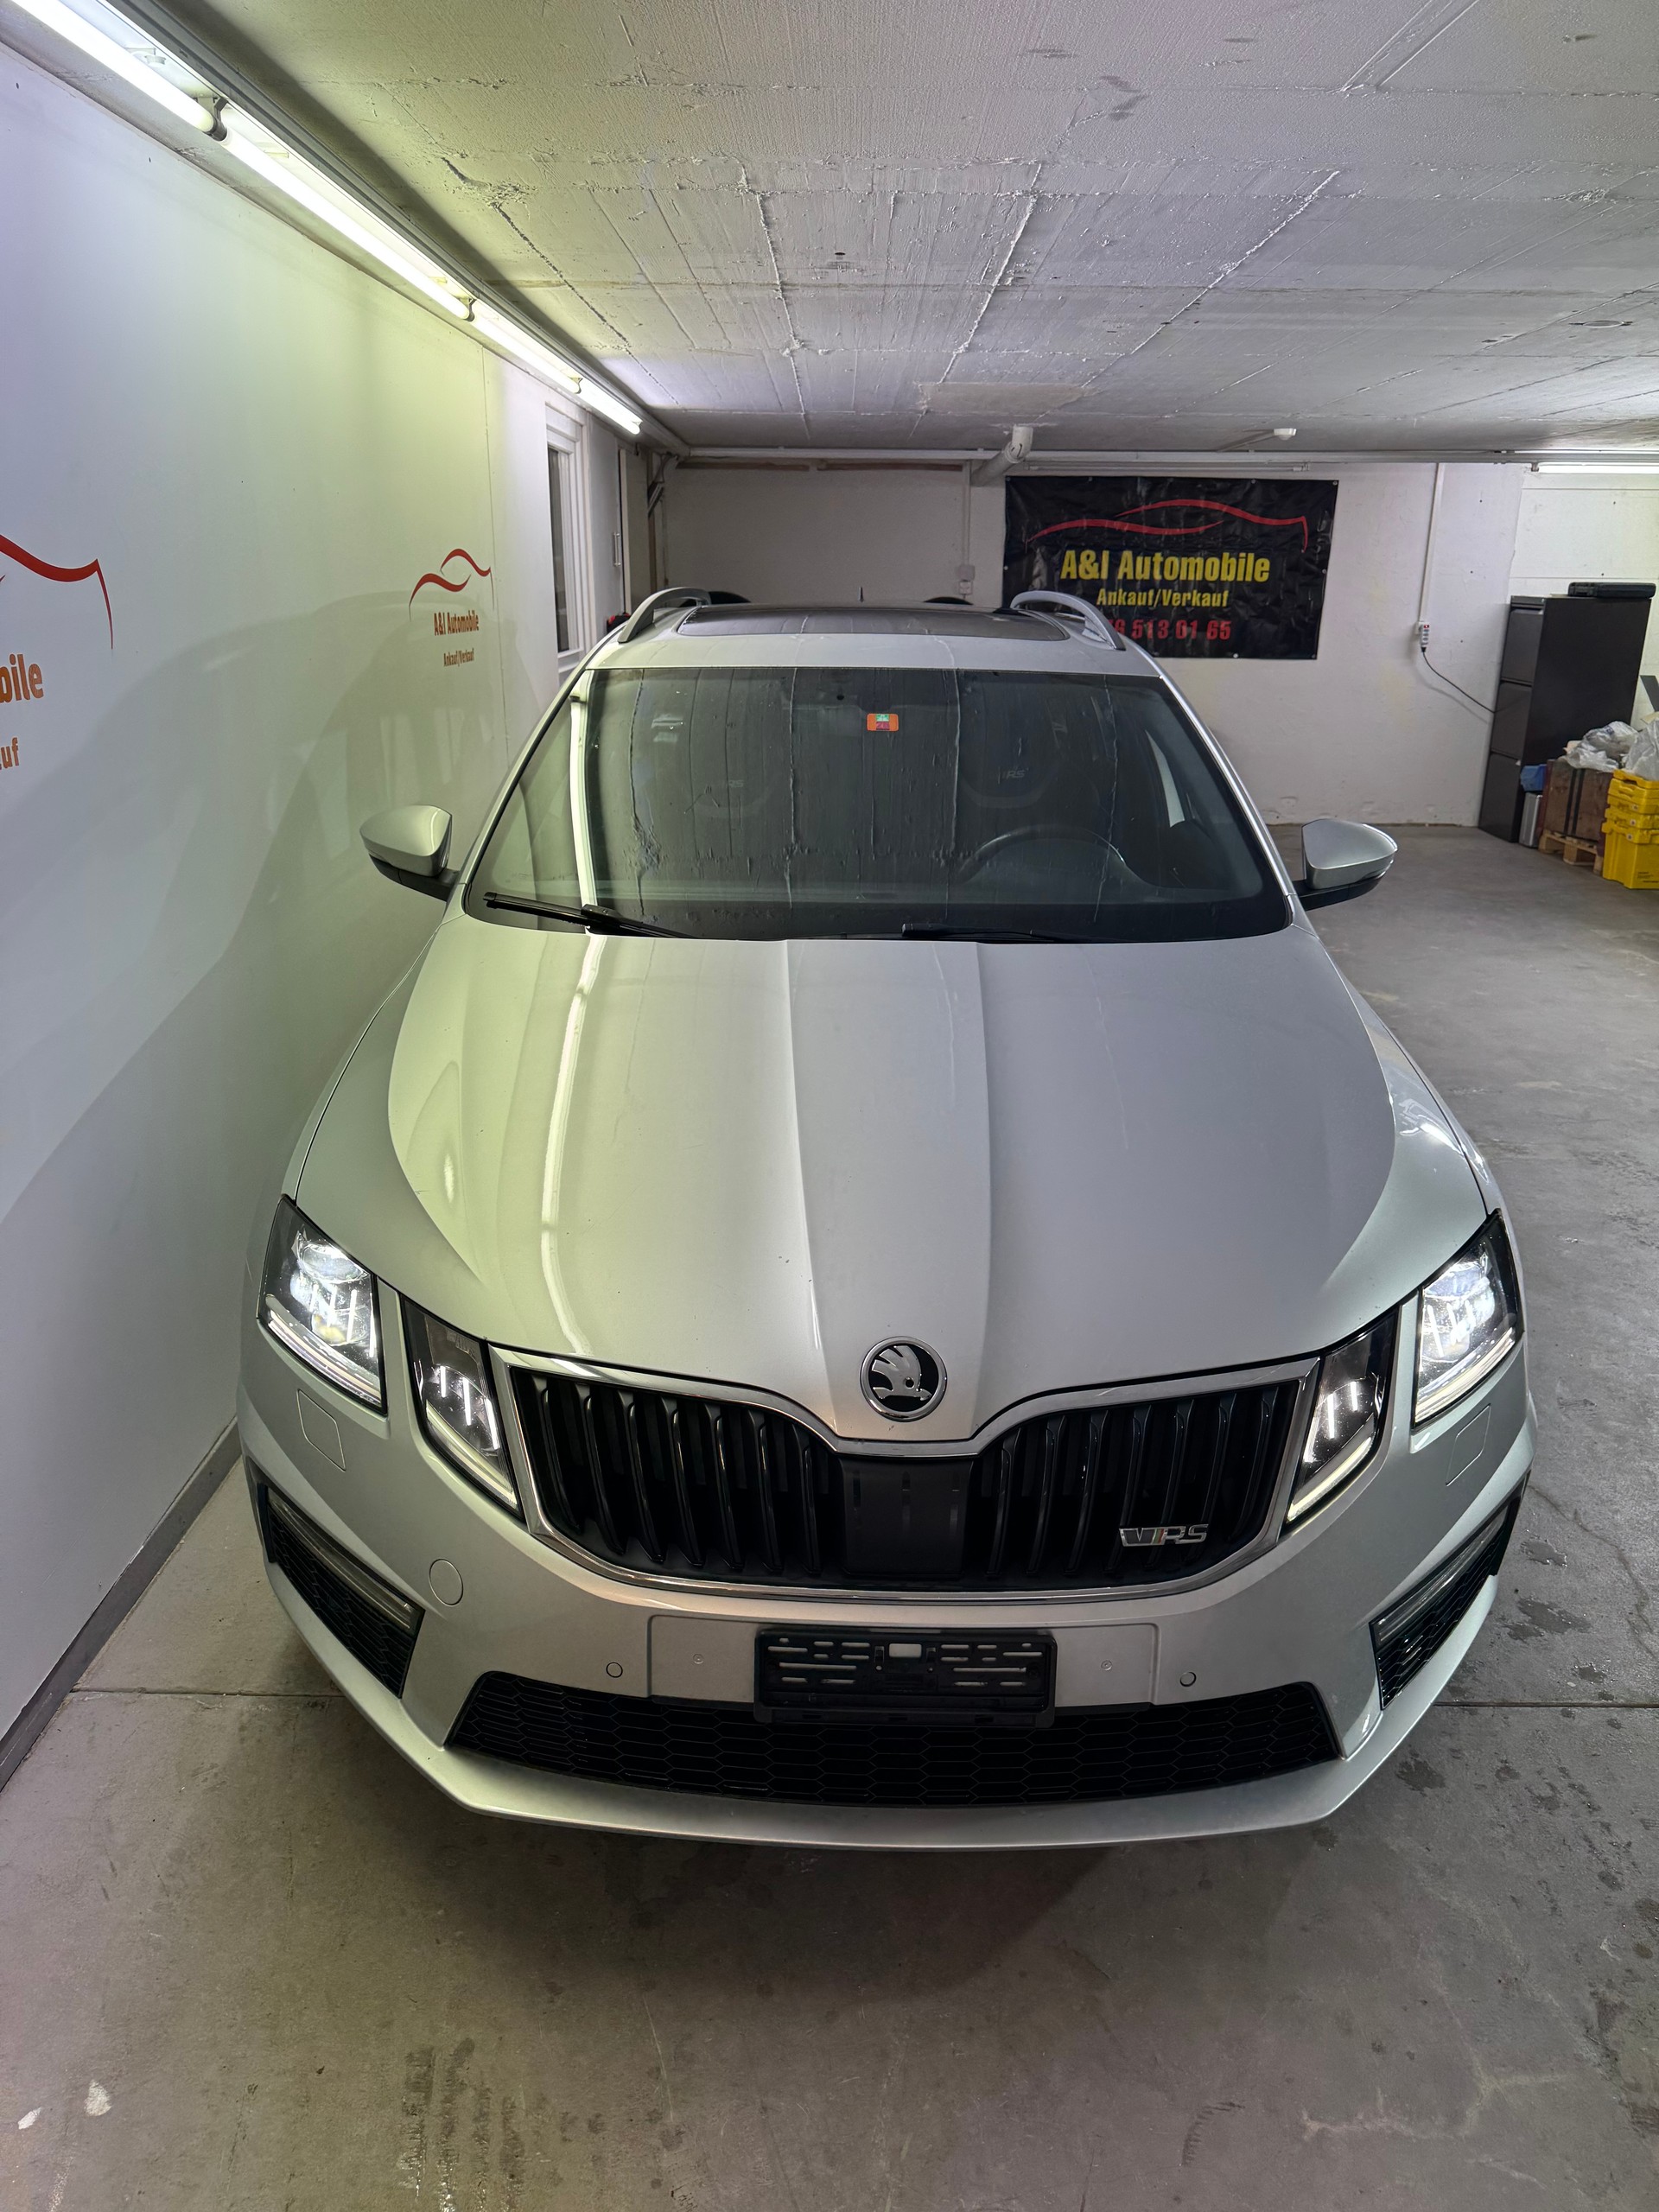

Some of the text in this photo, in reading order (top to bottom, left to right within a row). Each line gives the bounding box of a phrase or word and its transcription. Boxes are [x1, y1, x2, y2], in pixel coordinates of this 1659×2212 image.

[1060, 550, 1271, 582] A&I Automobile
[1096, 588, 1230, 607] Ankauf/Verkauf
[434, 610, 480, 636] A&I Automobile
[1108, 620, 1232, 640] 6 513 01 65
[443, 647, 474, 667] Ankauf/Verkauf
[0, 737, 20, 770] uf
